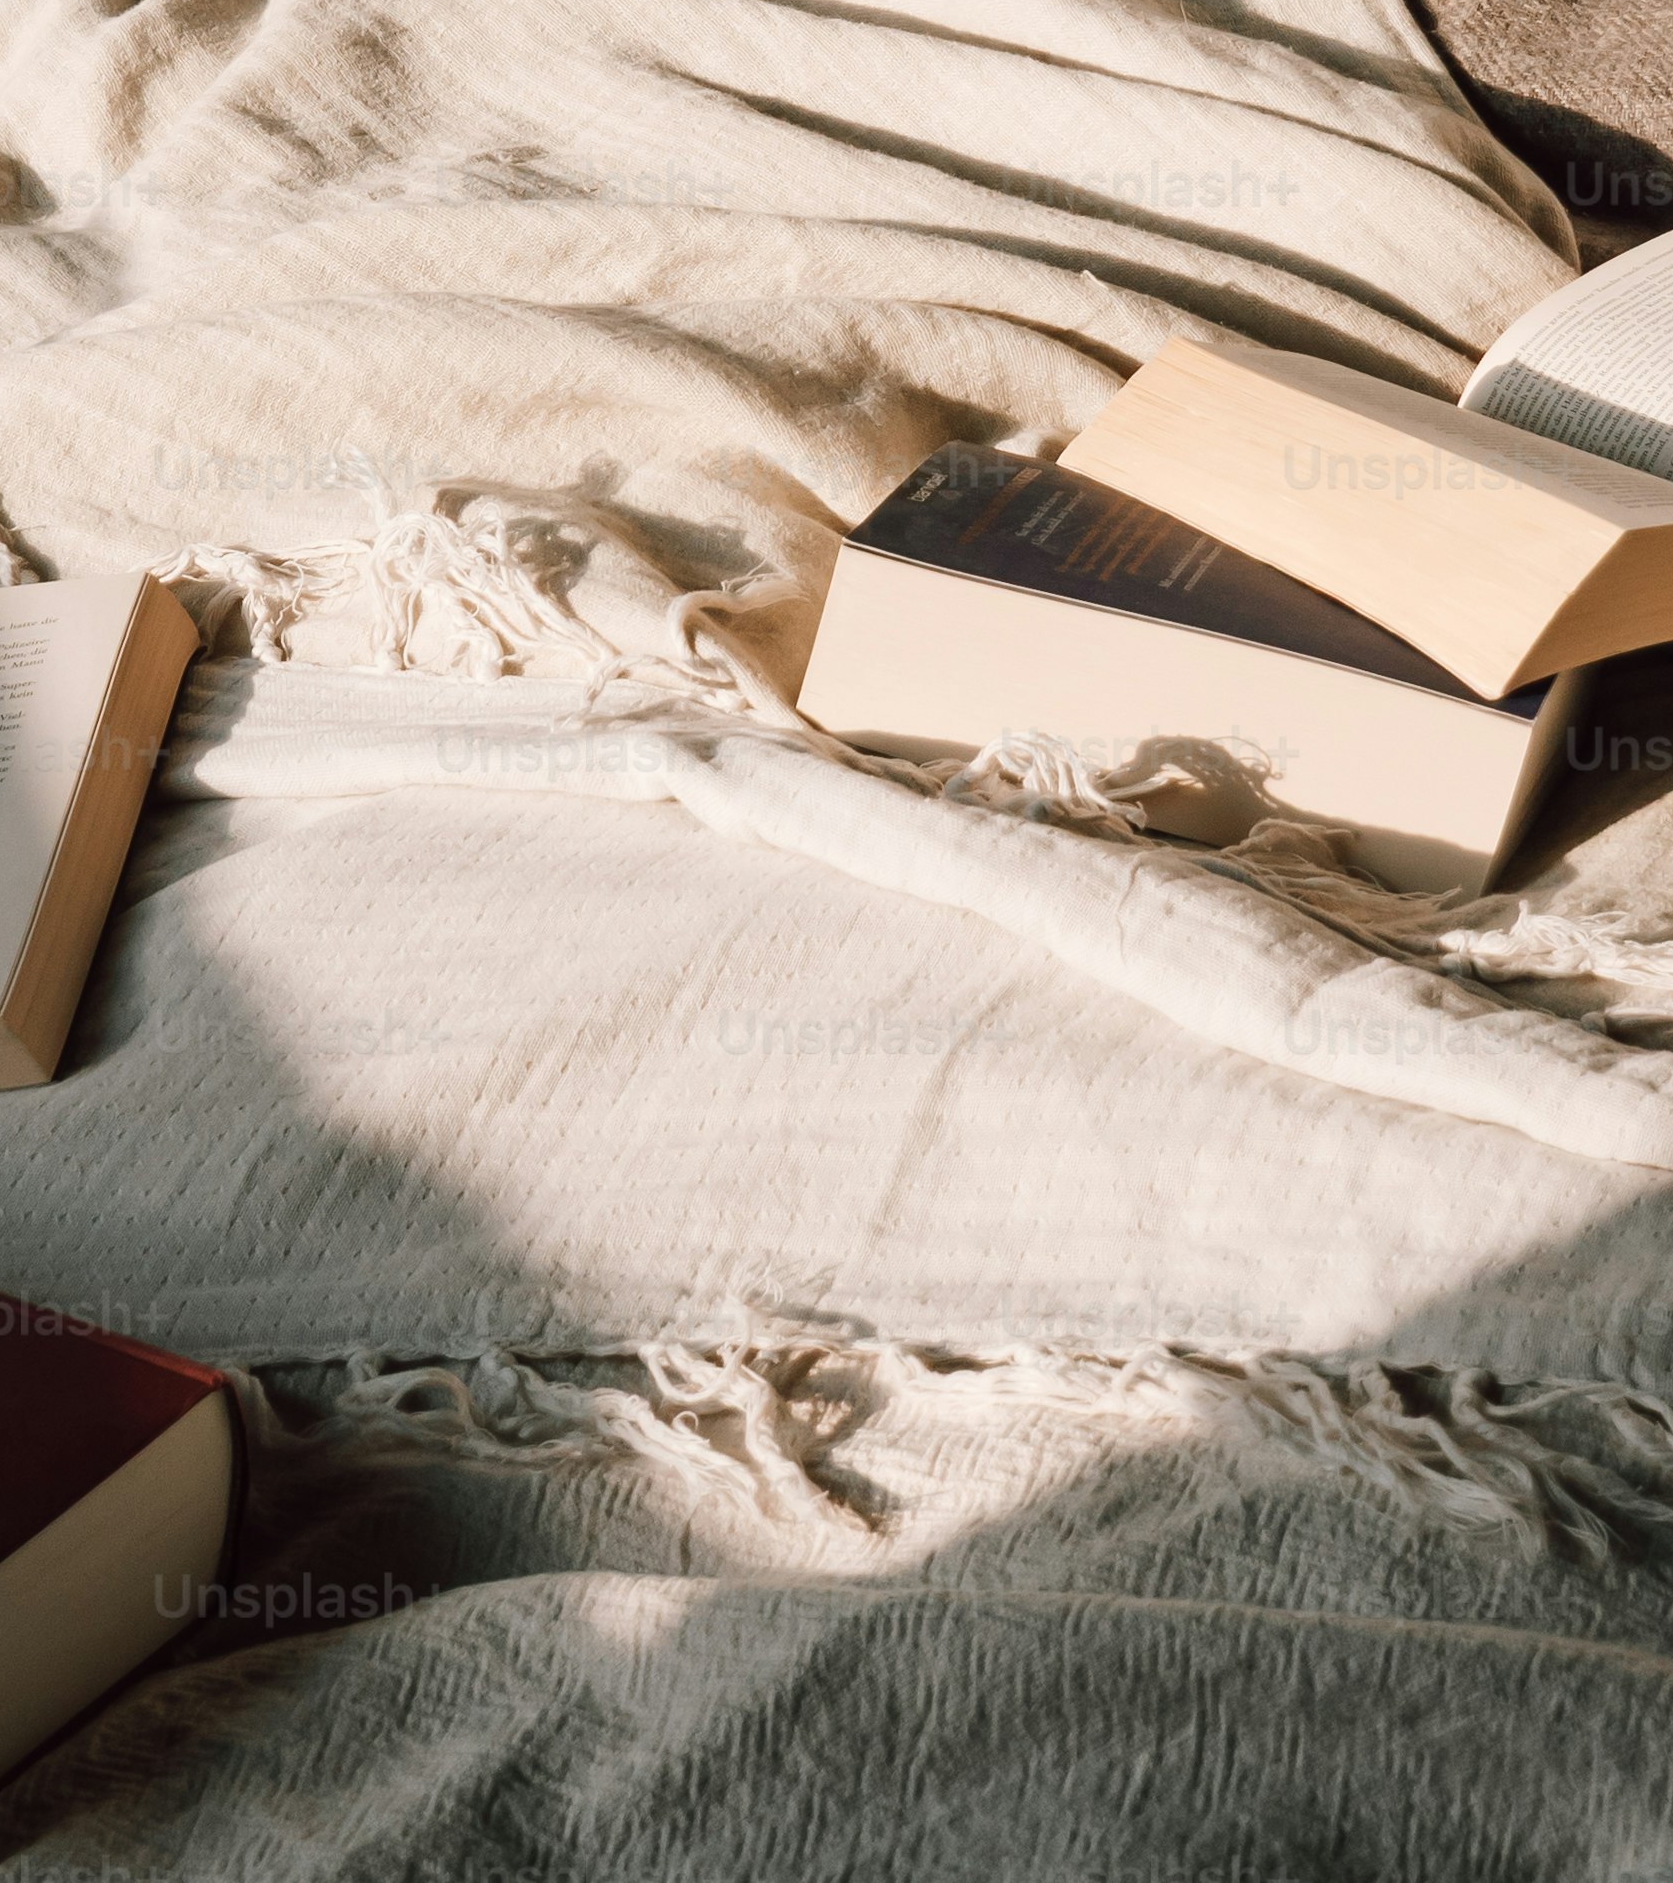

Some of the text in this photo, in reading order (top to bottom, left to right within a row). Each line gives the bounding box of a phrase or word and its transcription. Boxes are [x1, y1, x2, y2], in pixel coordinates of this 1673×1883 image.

[10, 620, 38, 630] hatte
[41, 617, 59, 626] die
[11, 659, 44, 669] Mann
